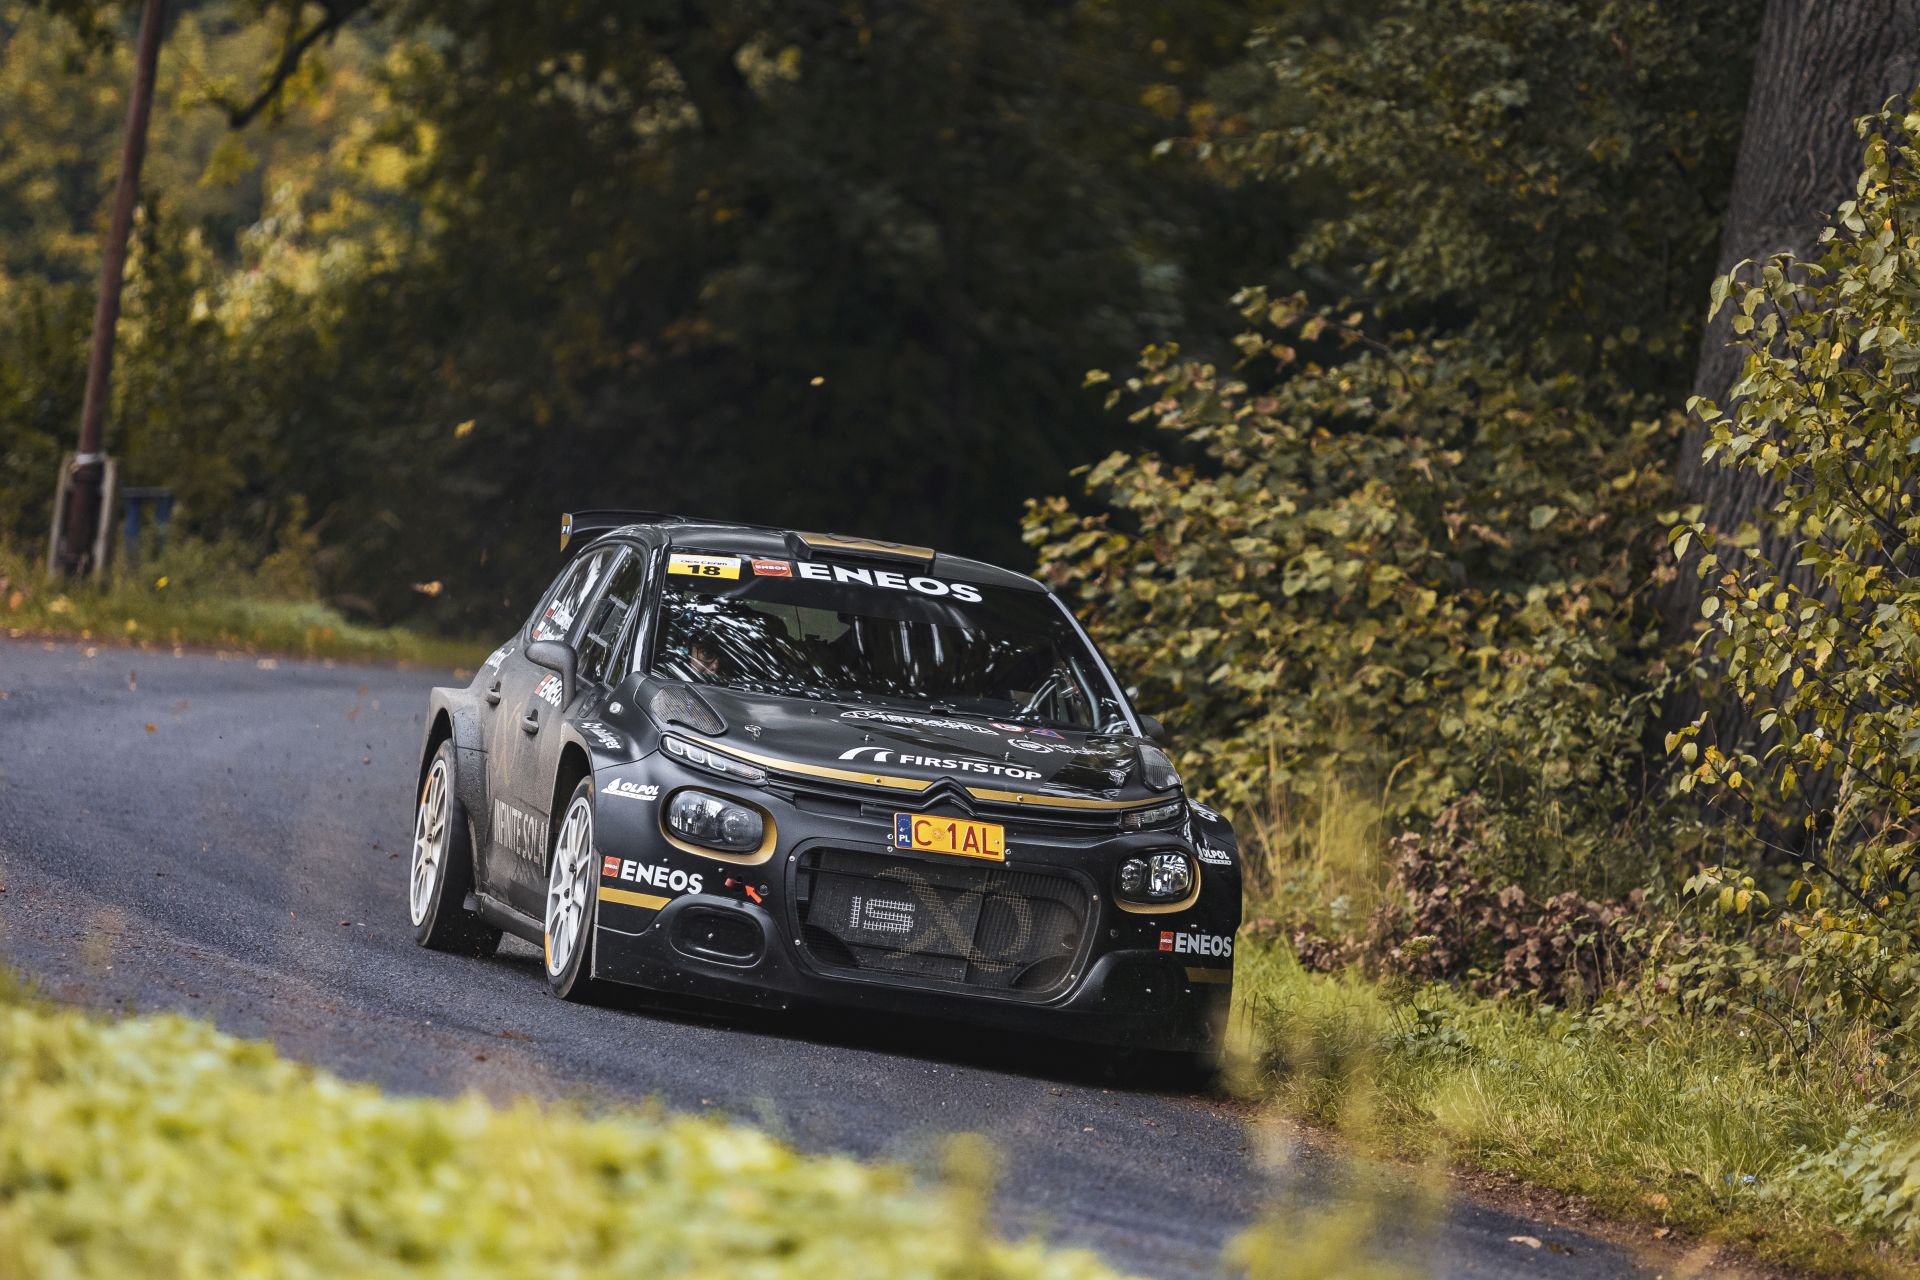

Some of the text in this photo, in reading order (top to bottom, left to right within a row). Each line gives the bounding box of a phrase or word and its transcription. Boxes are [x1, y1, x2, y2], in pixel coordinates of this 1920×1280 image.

[687, 564, 721, 576] 18
[798, 562, 983, 603] ENEOS
[899, 754, 1042, 780] FIRSTSTOP
[621, 781, 660, 796] OLPOL
[494, 798, 523, 855] INFINITE
[898, 834, 911, 844] PL
[914, 819, 999, 856] C 1AL
[1202, 847, 1230, 860] OLPOL
[620, 860, 704, 895] ENEOS
[1175, 932, 1232, 958] ENEOS
